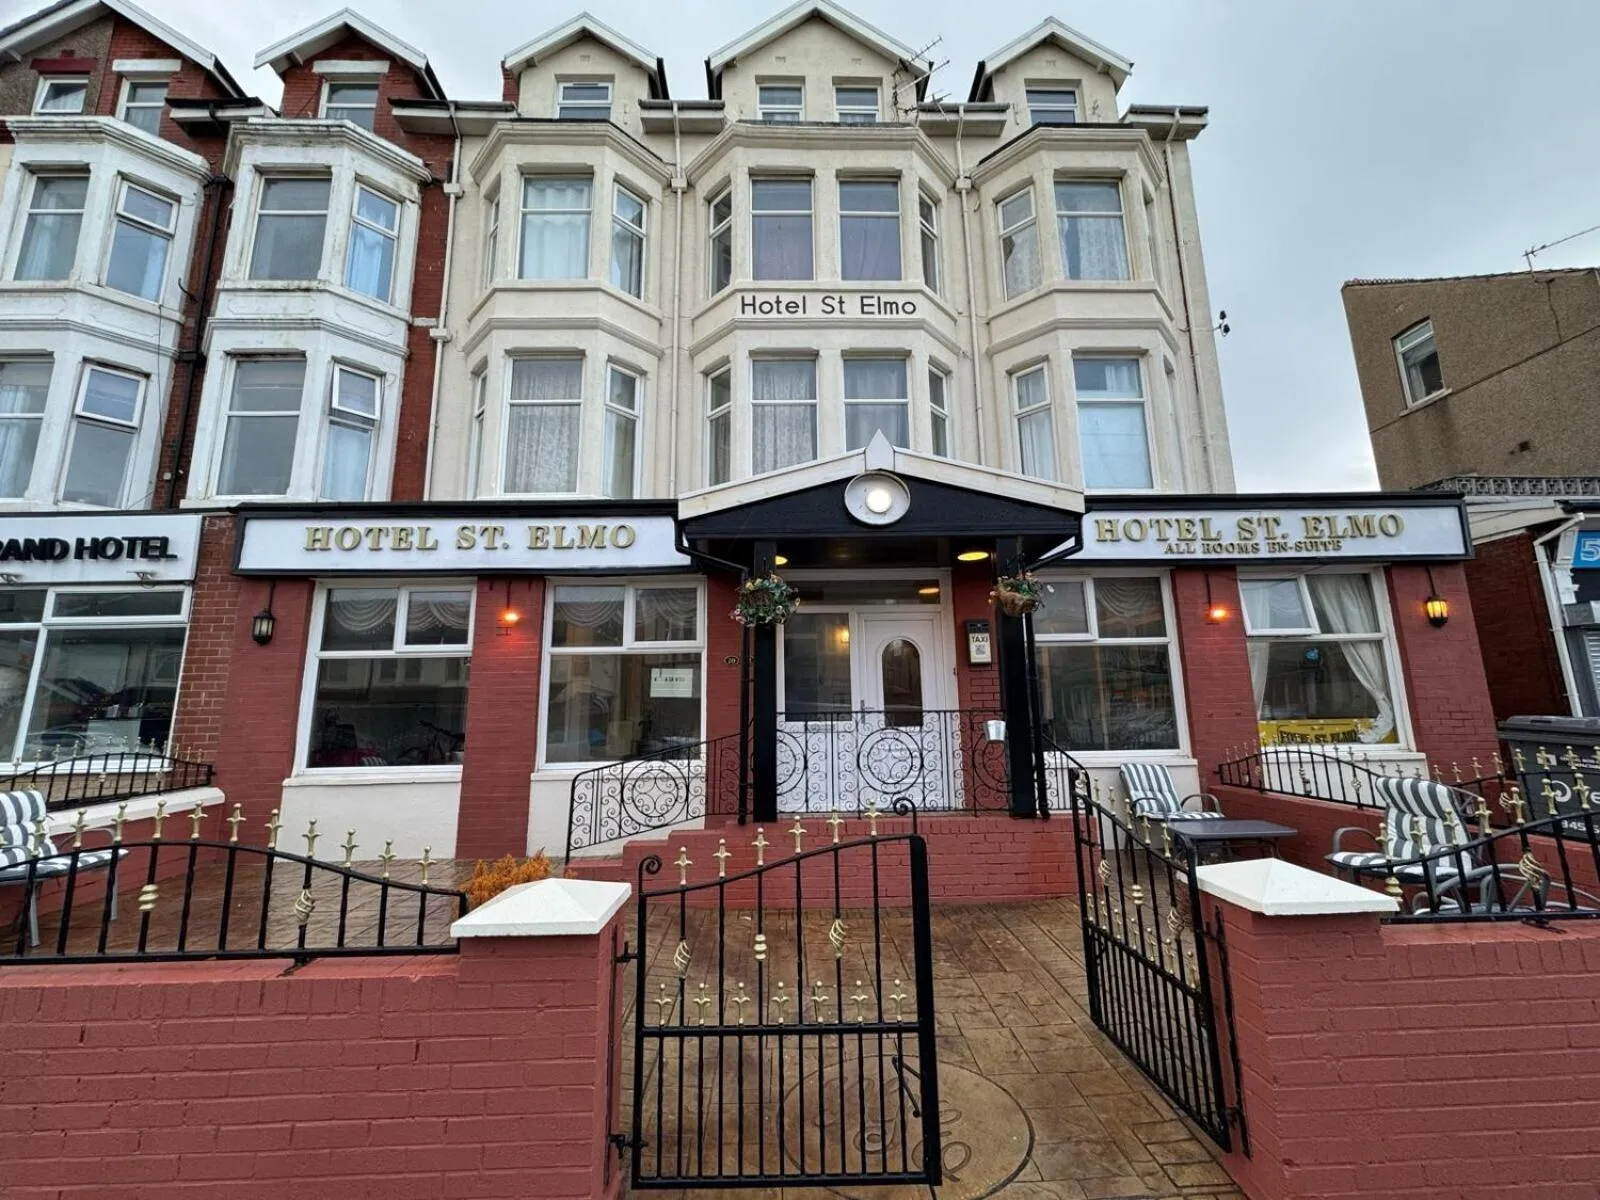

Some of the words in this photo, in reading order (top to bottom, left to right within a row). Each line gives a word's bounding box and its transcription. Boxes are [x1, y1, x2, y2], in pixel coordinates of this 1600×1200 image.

[740, 295, 807, 315] Hotel
[821, 295, 846, 314] St
[859, 295, 917, 315] Elmo
[304, 526, 439, 552] HOTEL
[456, 525, 510, 550] ST.
[527, 523, 637, 550] ELMO
[1094, 516, 1222, 543] HOTEL
[1236, 516, 1290, 541] ST.
[1301, 513, 1406, 540] ELMO
[73, 536, 178, 561] HOTEL
[1164, 543, 1196, 555] ALL
[1202, 542, 1260, 555] ROOMS
[1267, 540, 1343, 554] EN-SUITE
